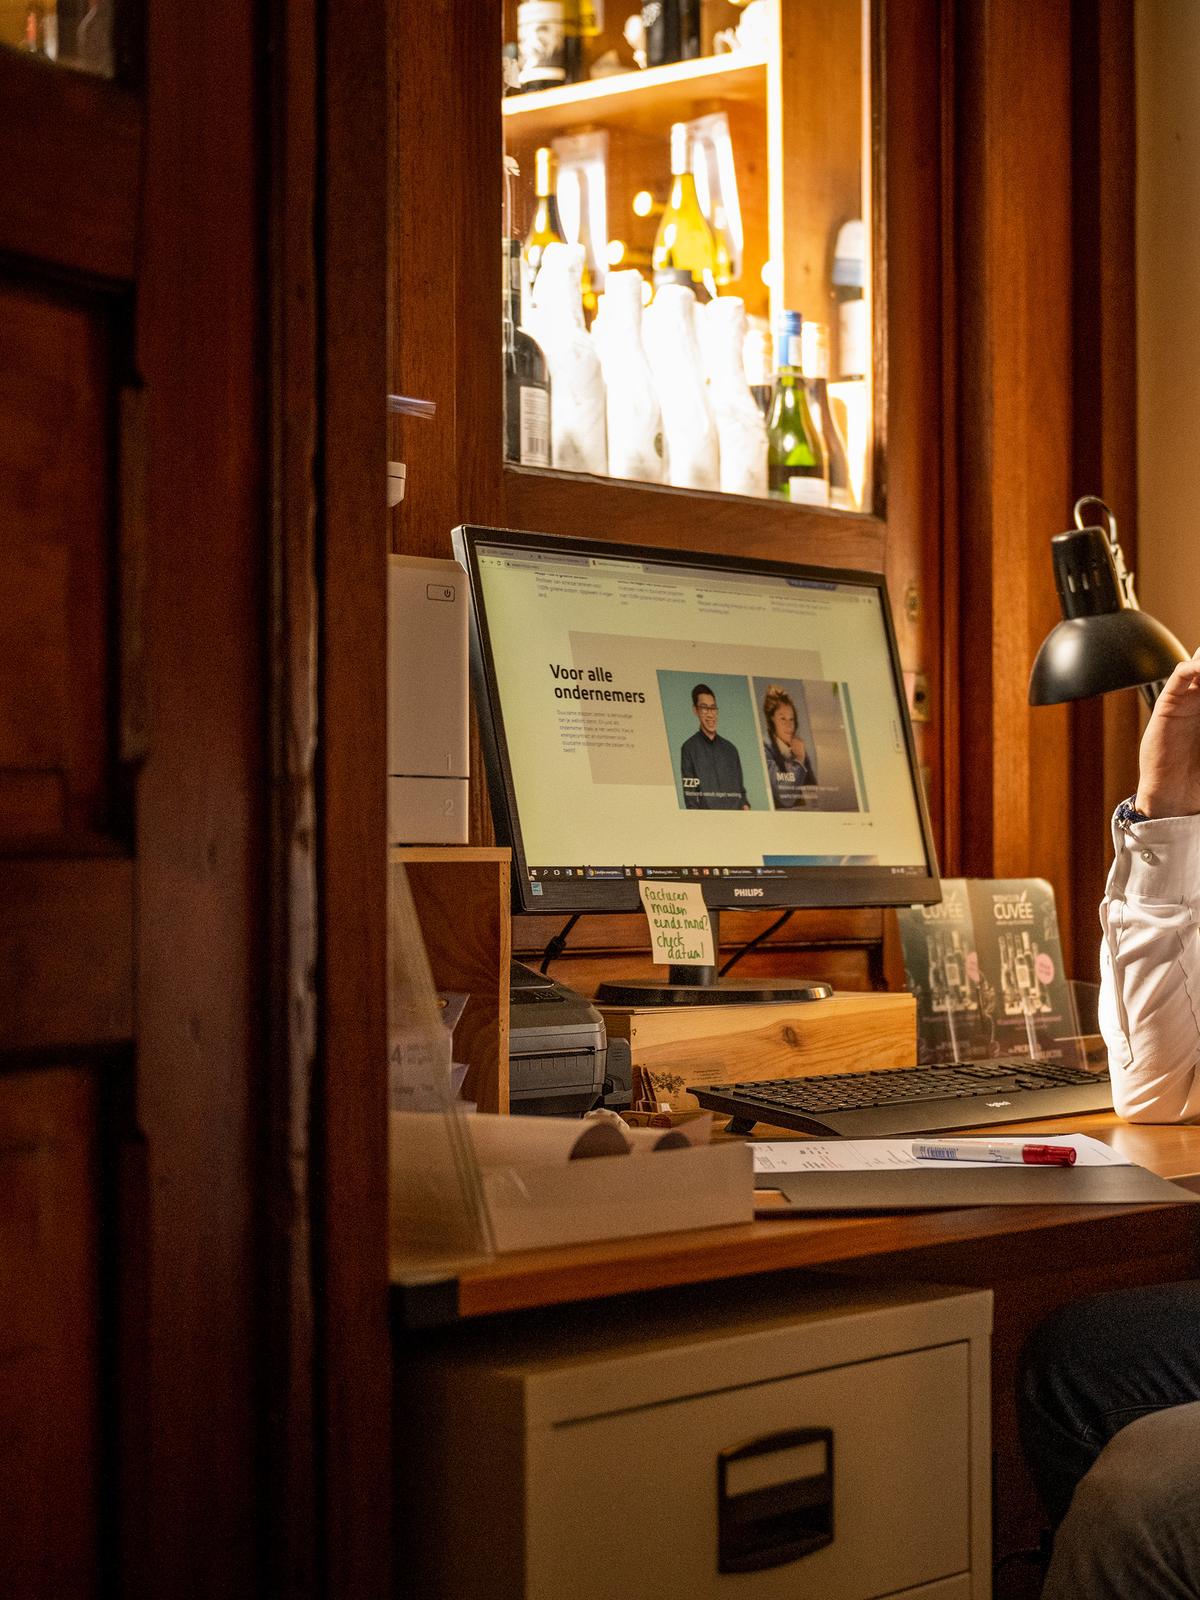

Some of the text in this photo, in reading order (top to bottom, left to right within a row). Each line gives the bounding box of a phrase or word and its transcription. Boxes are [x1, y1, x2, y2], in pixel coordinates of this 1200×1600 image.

[549, 664, 613, 682] Voor alle
[554, 685, 646, 703] ondernemers
[683, 777, 700, 788] ZZP
[776, 772, 796, 783] MKB
[644, 886, 688, 901] facturen
[734, 888, 764, 897] PHILIPS
[651, 902, 687, 917] mailen
